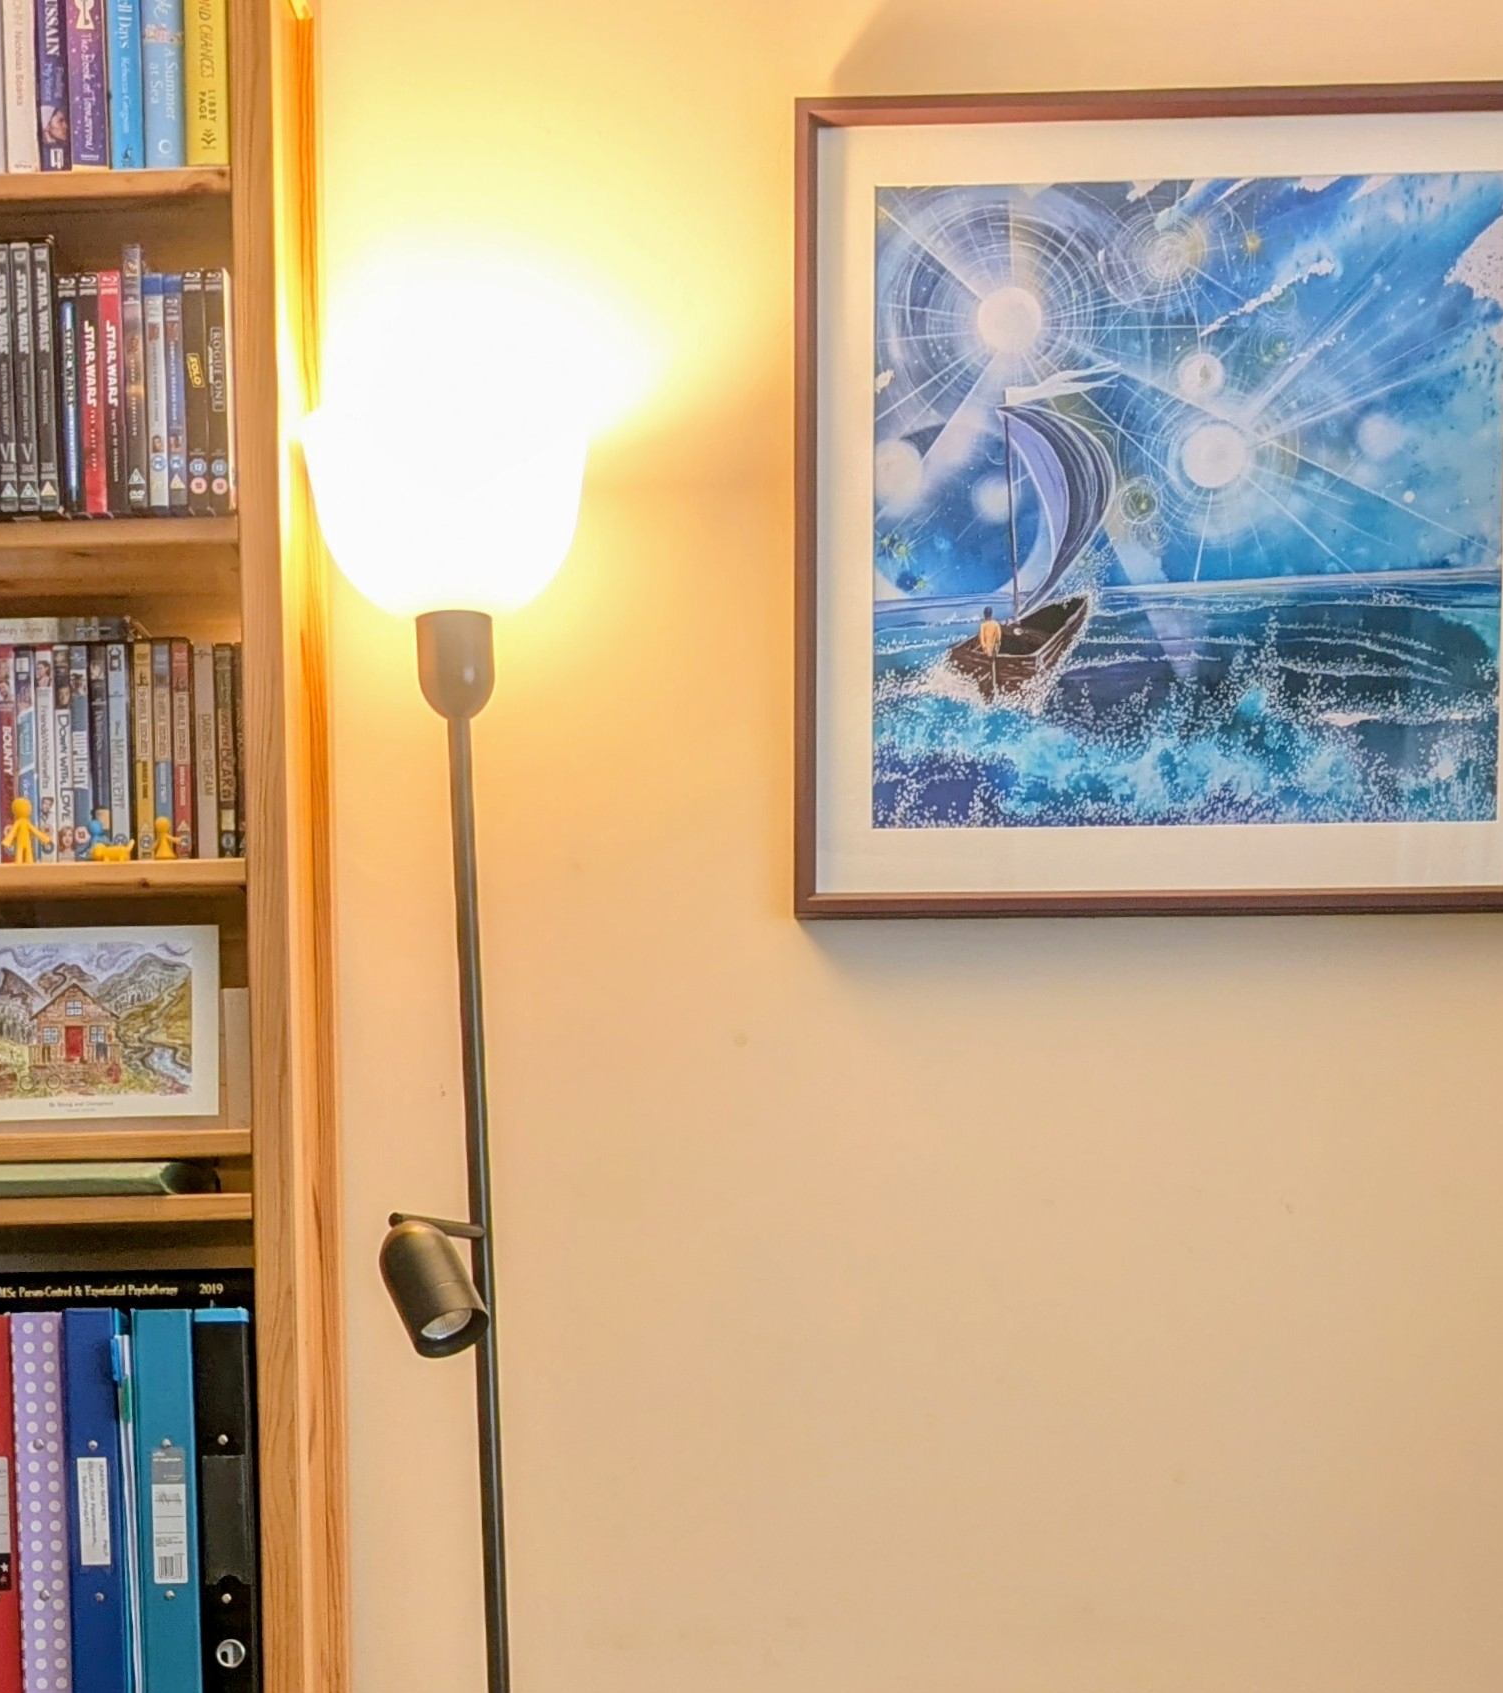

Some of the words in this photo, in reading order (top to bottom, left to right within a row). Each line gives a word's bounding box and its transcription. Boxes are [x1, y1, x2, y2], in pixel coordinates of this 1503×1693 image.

[199, 24, 216, 78] CHANCES
[163, 61, 179, 120] Summer
[16, 269, 28, 311] STAR
[36, 267, 48, 309] STAR
[17, 313, 30, 354] WARS
[37, 312, 50, 352] WARS
[83, 321, 95, 361] STAR
[105, 321, 116, 361] STAR
[85, 365, 97, 407] WARS
[107, 365, 118, 406] WARS
[2, 726, 13, 776] BOUNTY
[72, 731, 88, 789] DUPLICITY
[199, 1284, 224, 1296] 2019
